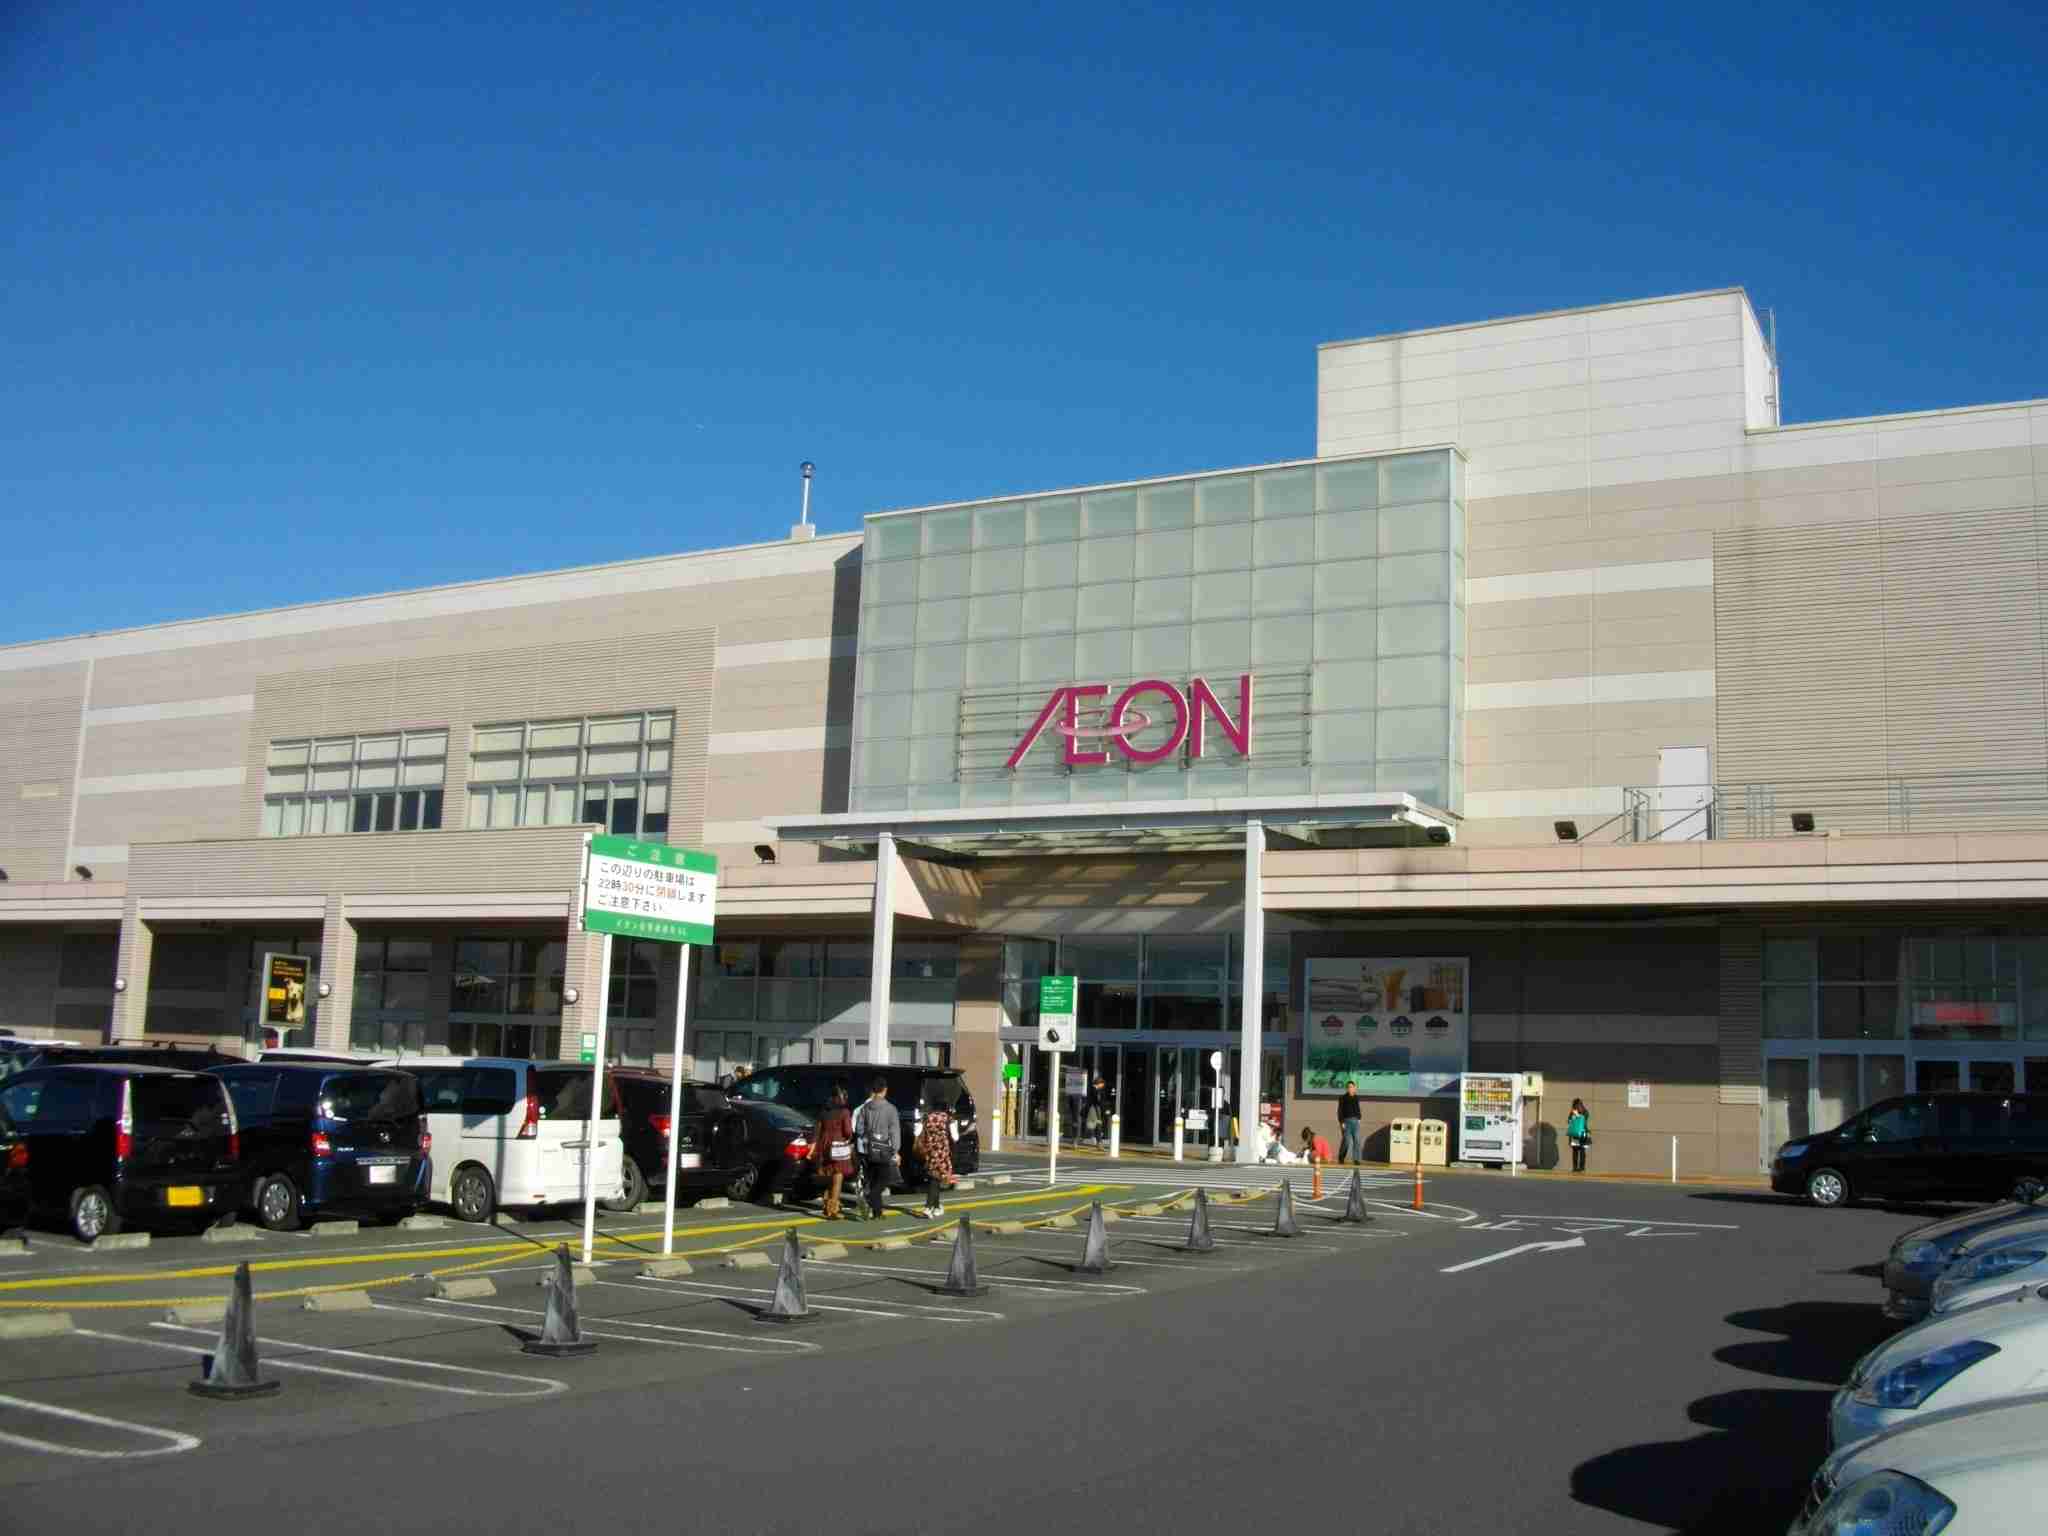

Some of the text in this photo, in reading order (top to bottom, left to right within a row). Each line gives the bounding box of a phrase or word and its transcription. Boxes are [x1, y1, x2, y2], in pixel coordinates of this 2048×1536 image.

[600, 862, 695, 888] この辺りの駐車場は
